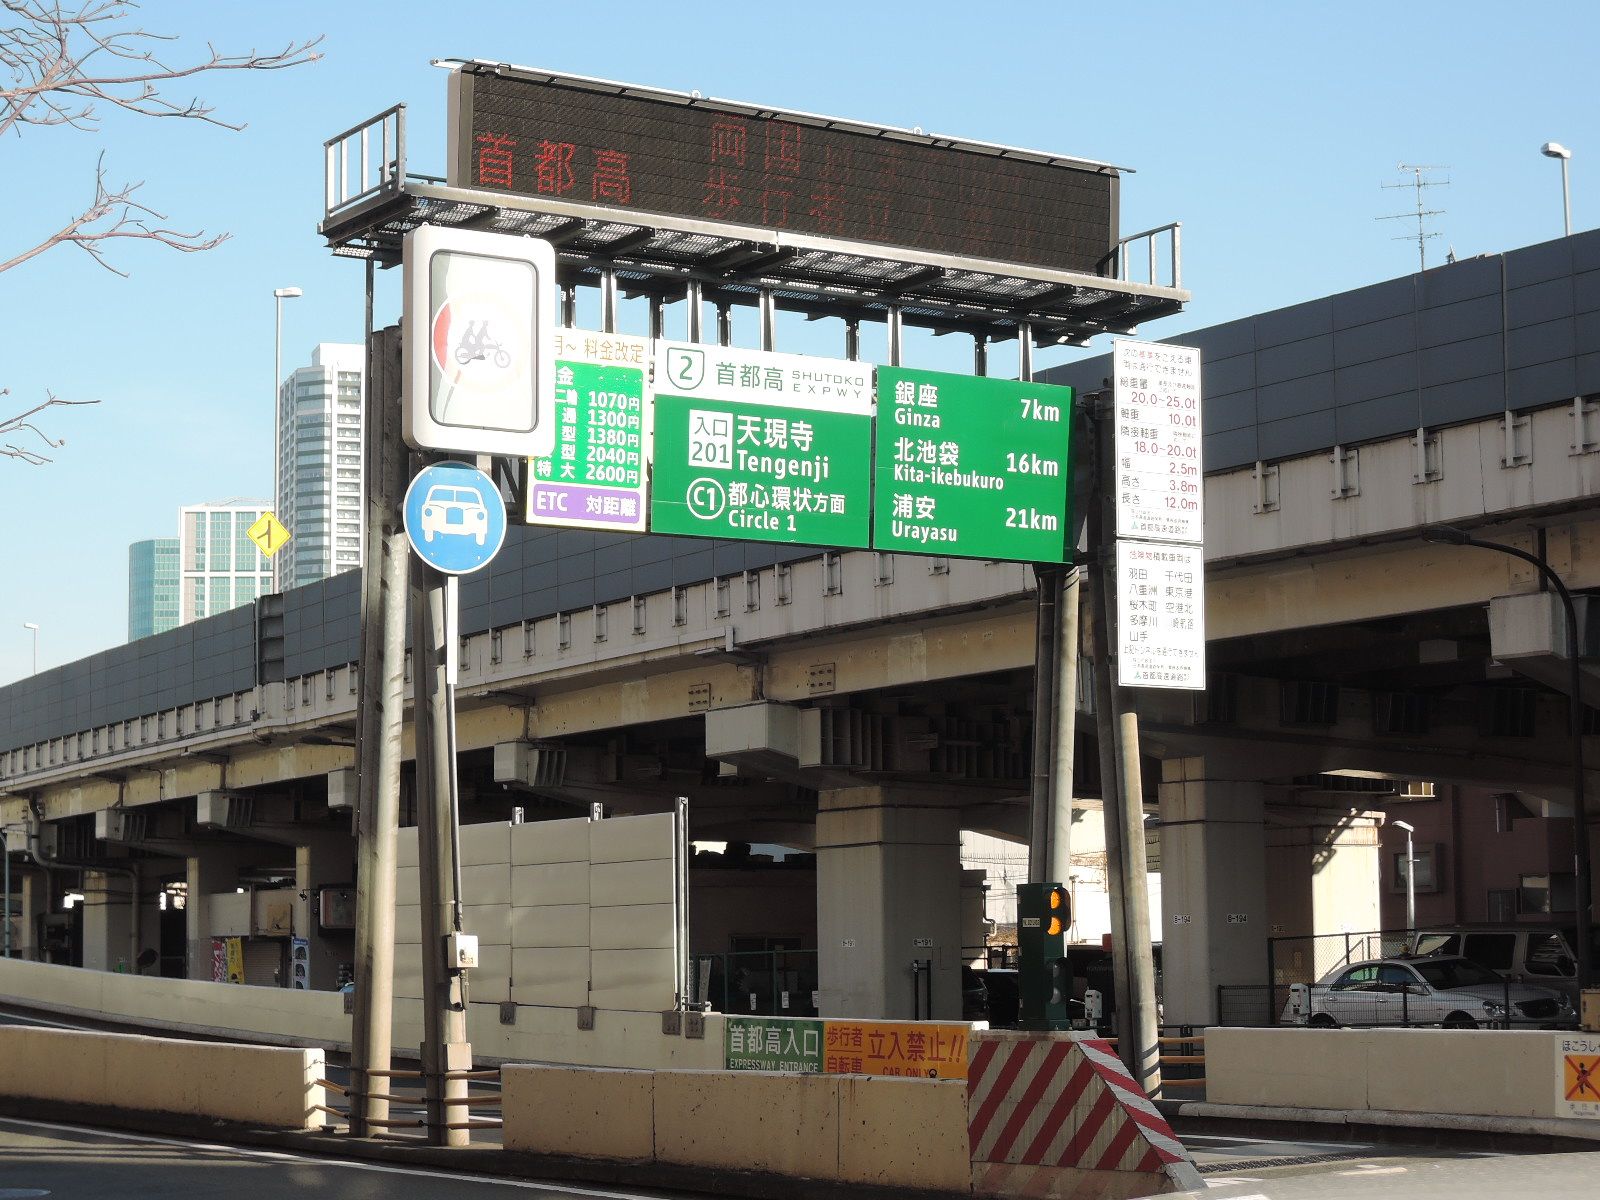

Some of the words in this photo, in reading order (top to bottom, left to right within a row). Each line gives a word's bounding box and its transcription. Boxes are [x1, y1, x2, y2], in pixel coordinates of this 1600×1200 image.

[476, 132, 632, 204] 首都高
[584, 338, 644, 363] 料金改定
[679, 355, 693, 380] 2
[716, 361, 784, 392] 首都高
[791, 370, 864, 387] SHUTOKO
[588, 390, 640, 411] 1070円
[894, 380, 938, 408] 銀座
[588, 408, 640, 429] 1300円
[894, 407, 941, 428] Ginza
[1020, 399, 1060, 422] 7km
[587, 427, 639, 447] 1380円
[694, 416, 728, 438] 入口
[736, 414, 814, 451] 天現寺
[586, 445, 639, 466] 2040円
[691, 441, 730, 464] 201
[894, 436, 959, 467] 北池袋
[585, 463, 638, 484] 2600円
[736, 449, 829, 483] Tengenji
[1006, 452, 1059, 477] 16km
[1169, 462, 1197, 476] 2.5m
[894, 464, 1004, 490] Kita-ikebukuro
[1169, 479, 1198, 493] 3.8m
[536, 490, 569, 512] ETC
[585, 494, 637, 517] 対距離
[693, 486, 715, 511] C1
[728, 481, 846, 514] 都心環状方面
[892, 492, 936, 520] 浦安
[1165, 496, 1198, 510] 12.0m
[728, 509, 780, 530] Circle
[786, 514, 797, 532] 1
[1005, 507, 1057, 531] 21km
[892, 520, 957, 543] Urayasu
[1128, 567, 1148, 580] 羽田
[1165, 570, 1193, 584] 千代田
[1128, 583, 1158, 596] 八重洲
[1129, 631, 1148, 642] 山手
[729, 1024, 819, 1057] 首都高入口
[826, 1025, 863, 1047] 歩行者
[730, 1058, 776, 1071] EXPRESSWAY
[779, 1060, 819, 1073] ENTRANCE
[826, 1055, 863, 1074] 自転車
